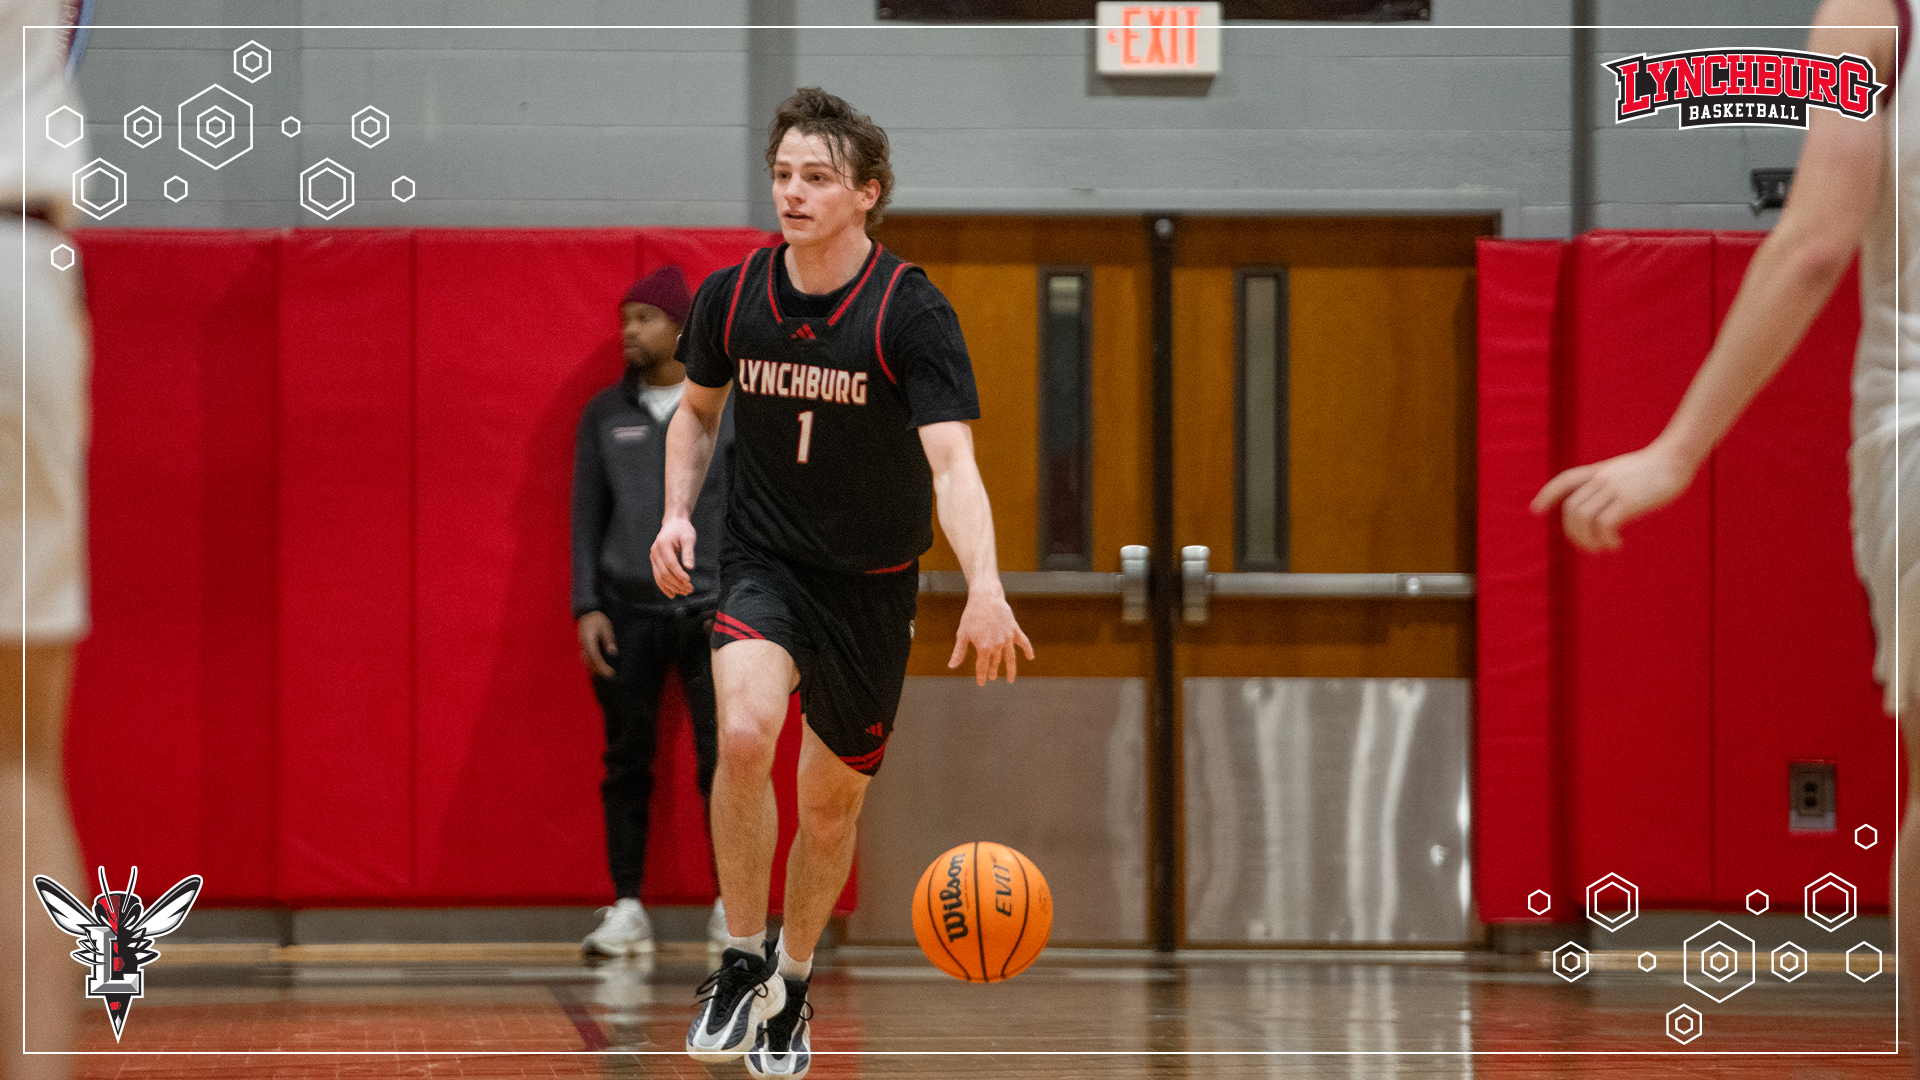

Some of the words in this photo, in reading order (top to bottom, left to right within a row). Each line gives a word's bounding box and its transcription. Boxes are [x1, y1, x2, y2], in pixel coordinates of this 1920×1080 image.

[1121, 6, 1200, 66] EXIT
[739, 358, 868, 405] LYNCHBURG
[797, 411, 814, 463] 1
[940, 852, 968, 943] Wilson
